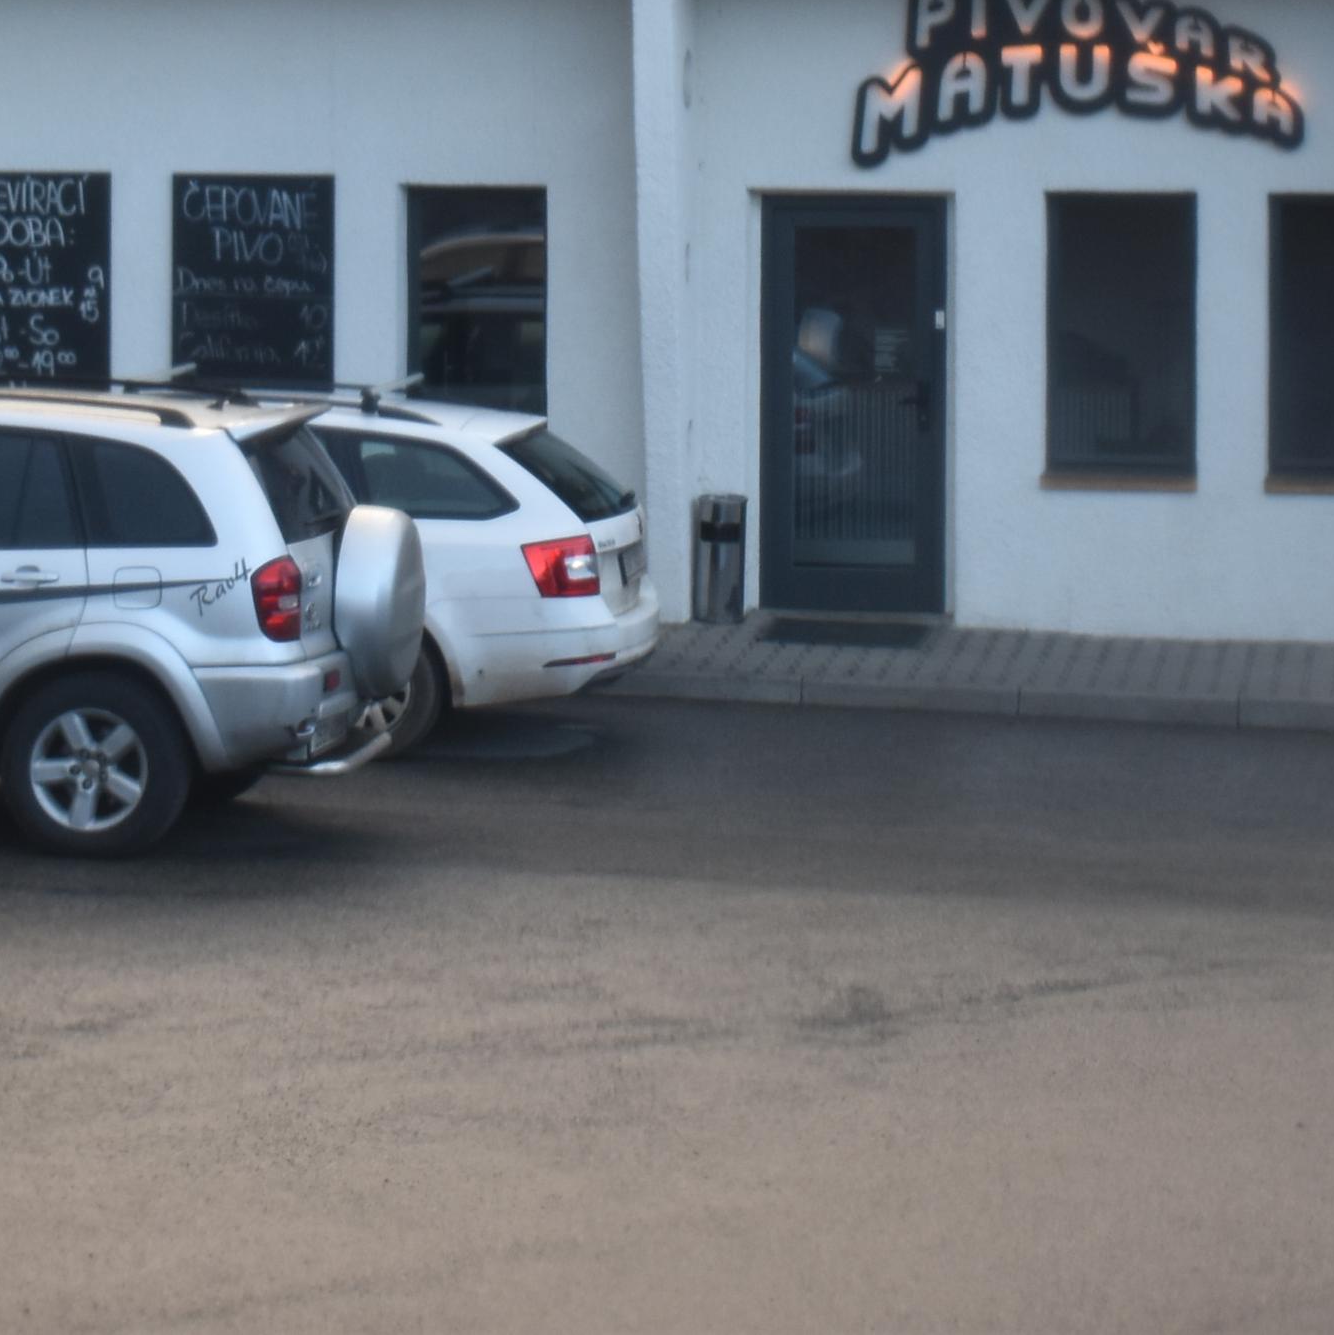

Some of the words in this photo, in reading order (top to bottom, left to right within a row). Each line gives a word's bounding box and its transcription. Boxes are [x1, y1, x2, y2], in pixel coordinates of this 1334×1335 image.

[856, 40, 1300, 161] MATUŠKA
[212, 227, 284, 265] PIVO
[9, 286, 74, 308] ZVONEK
[189, 555, 252, 618] Rav4
